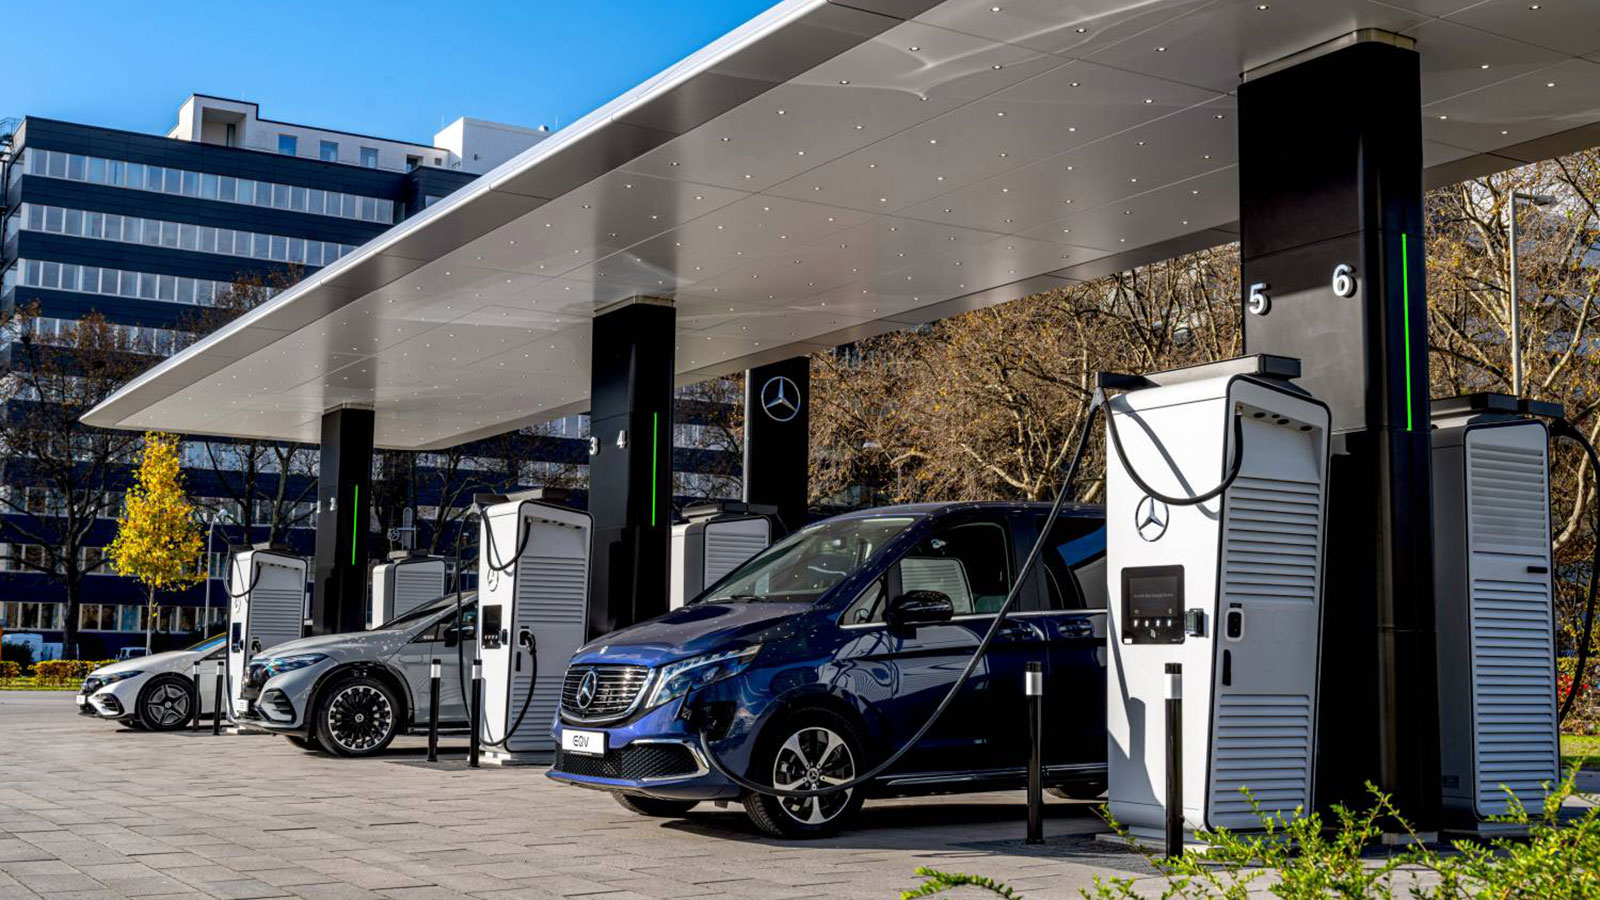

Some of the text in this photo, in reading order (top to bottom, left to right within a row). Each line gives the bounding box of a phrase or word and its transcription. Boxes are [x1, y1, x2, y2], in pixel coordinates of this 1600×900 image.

[1248, 263, 1355, 315] 5 6
[589, 429, 626, 456] 3 4
[572, 735, 590, 748] EQV
